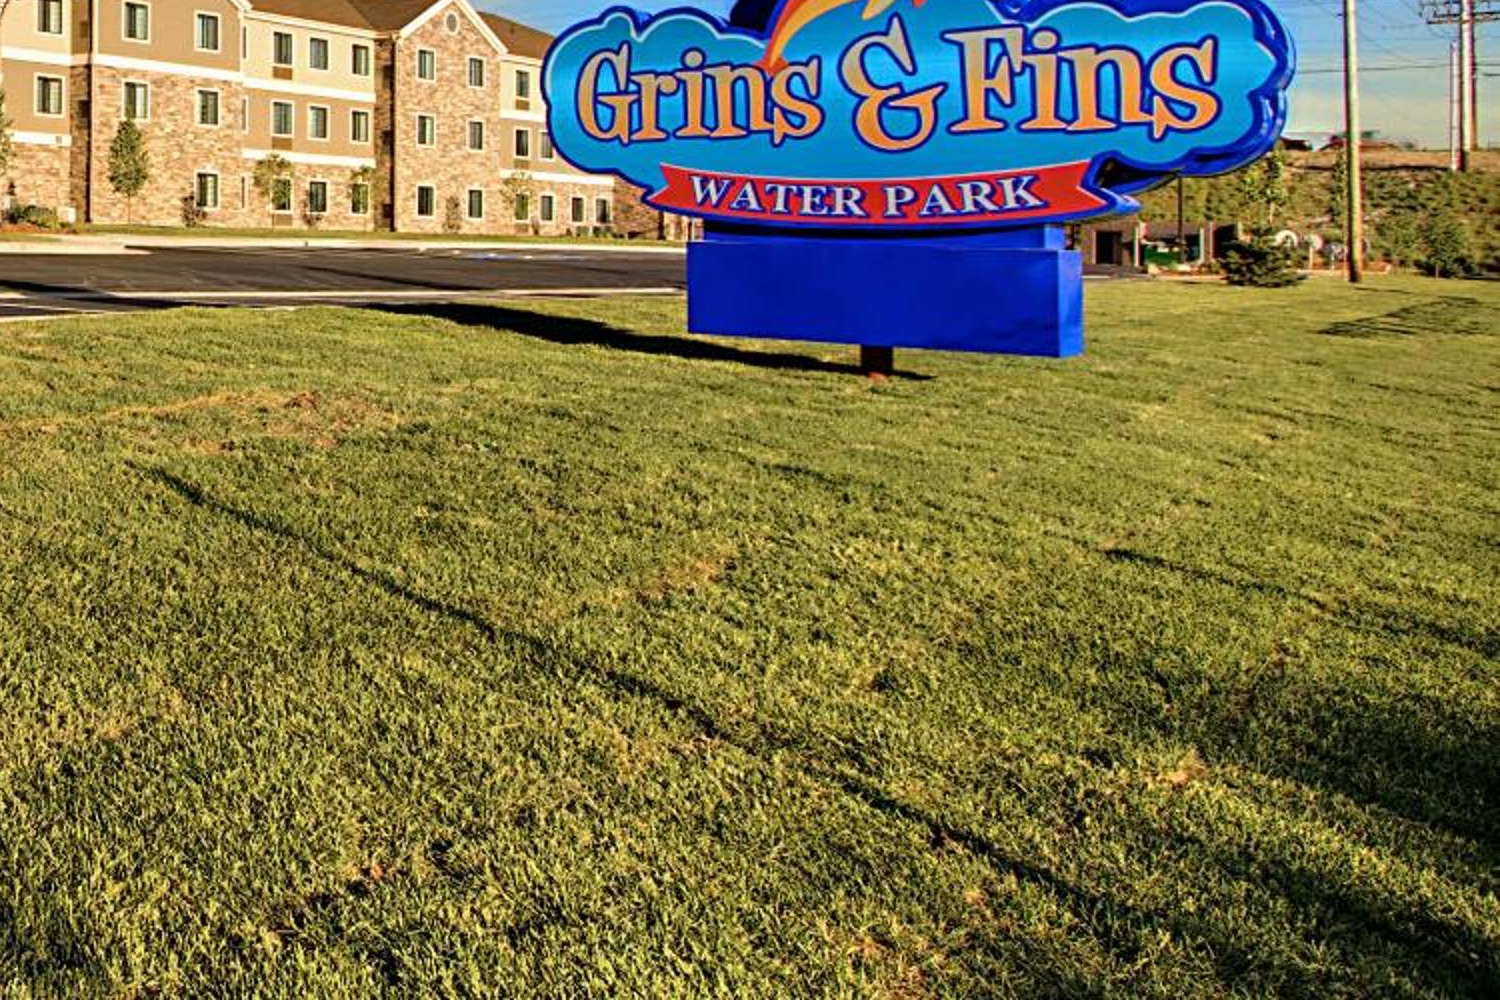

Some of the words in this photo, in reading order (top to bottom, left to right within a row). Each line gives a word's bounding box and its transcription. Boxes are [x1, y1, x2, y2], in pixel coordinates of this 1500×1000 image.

[577, 43, 823, 145] Grins
[839, 12, 948, 152] &
[942, 25, 1221, 140] Fins
[689, 174, 867, 217] WATER
[884, 174, 1046, 217] PARK
